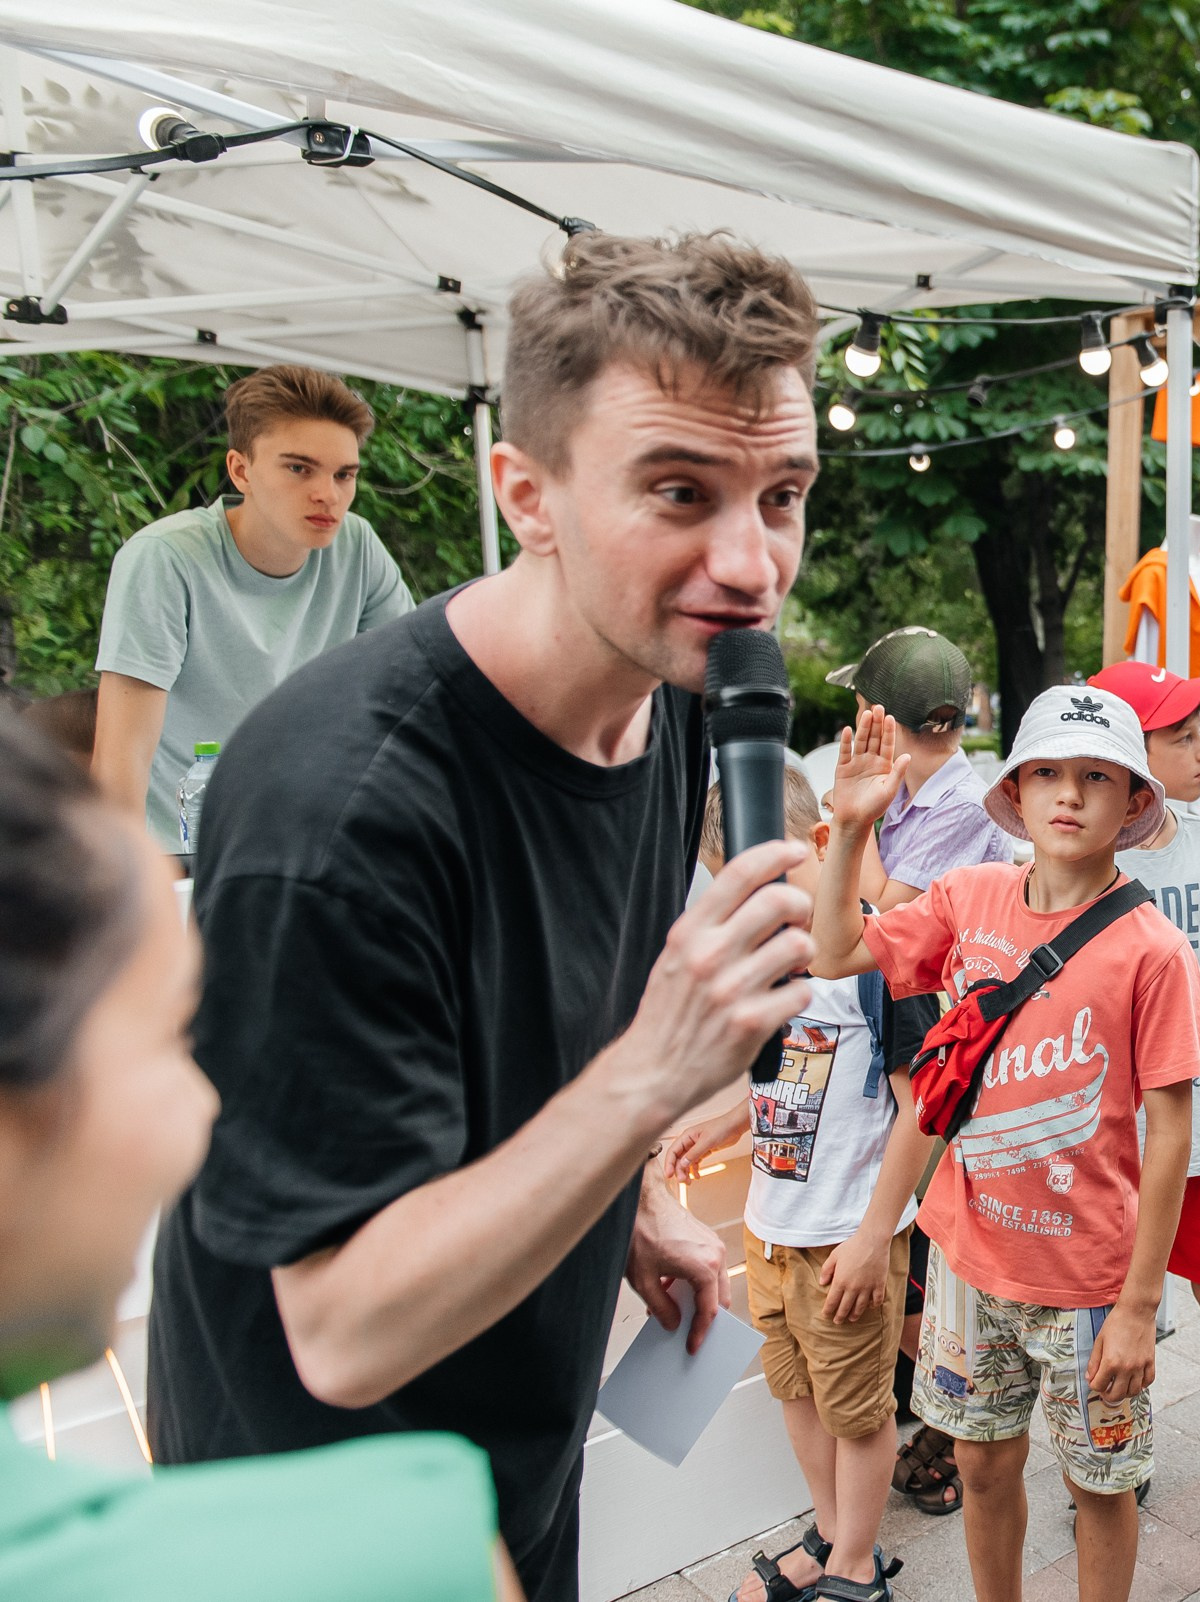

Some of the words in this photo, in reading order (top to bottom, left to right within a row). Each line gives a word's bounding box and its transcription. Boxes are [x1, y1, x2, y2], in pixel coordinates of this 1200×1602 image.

[1060, 710, 1110, 728] adidas
[1148, 882, 1200, 933] DE
[969, 927, 1018, 957] Industries
[1051, 1174, 1069, 1186] 63
[978, 1192, 1024, 1221] SINCE
[1030, 1209, 1074, 1227] 1863
[1001, 1219, 1072, 1238] ESTABLISHED
